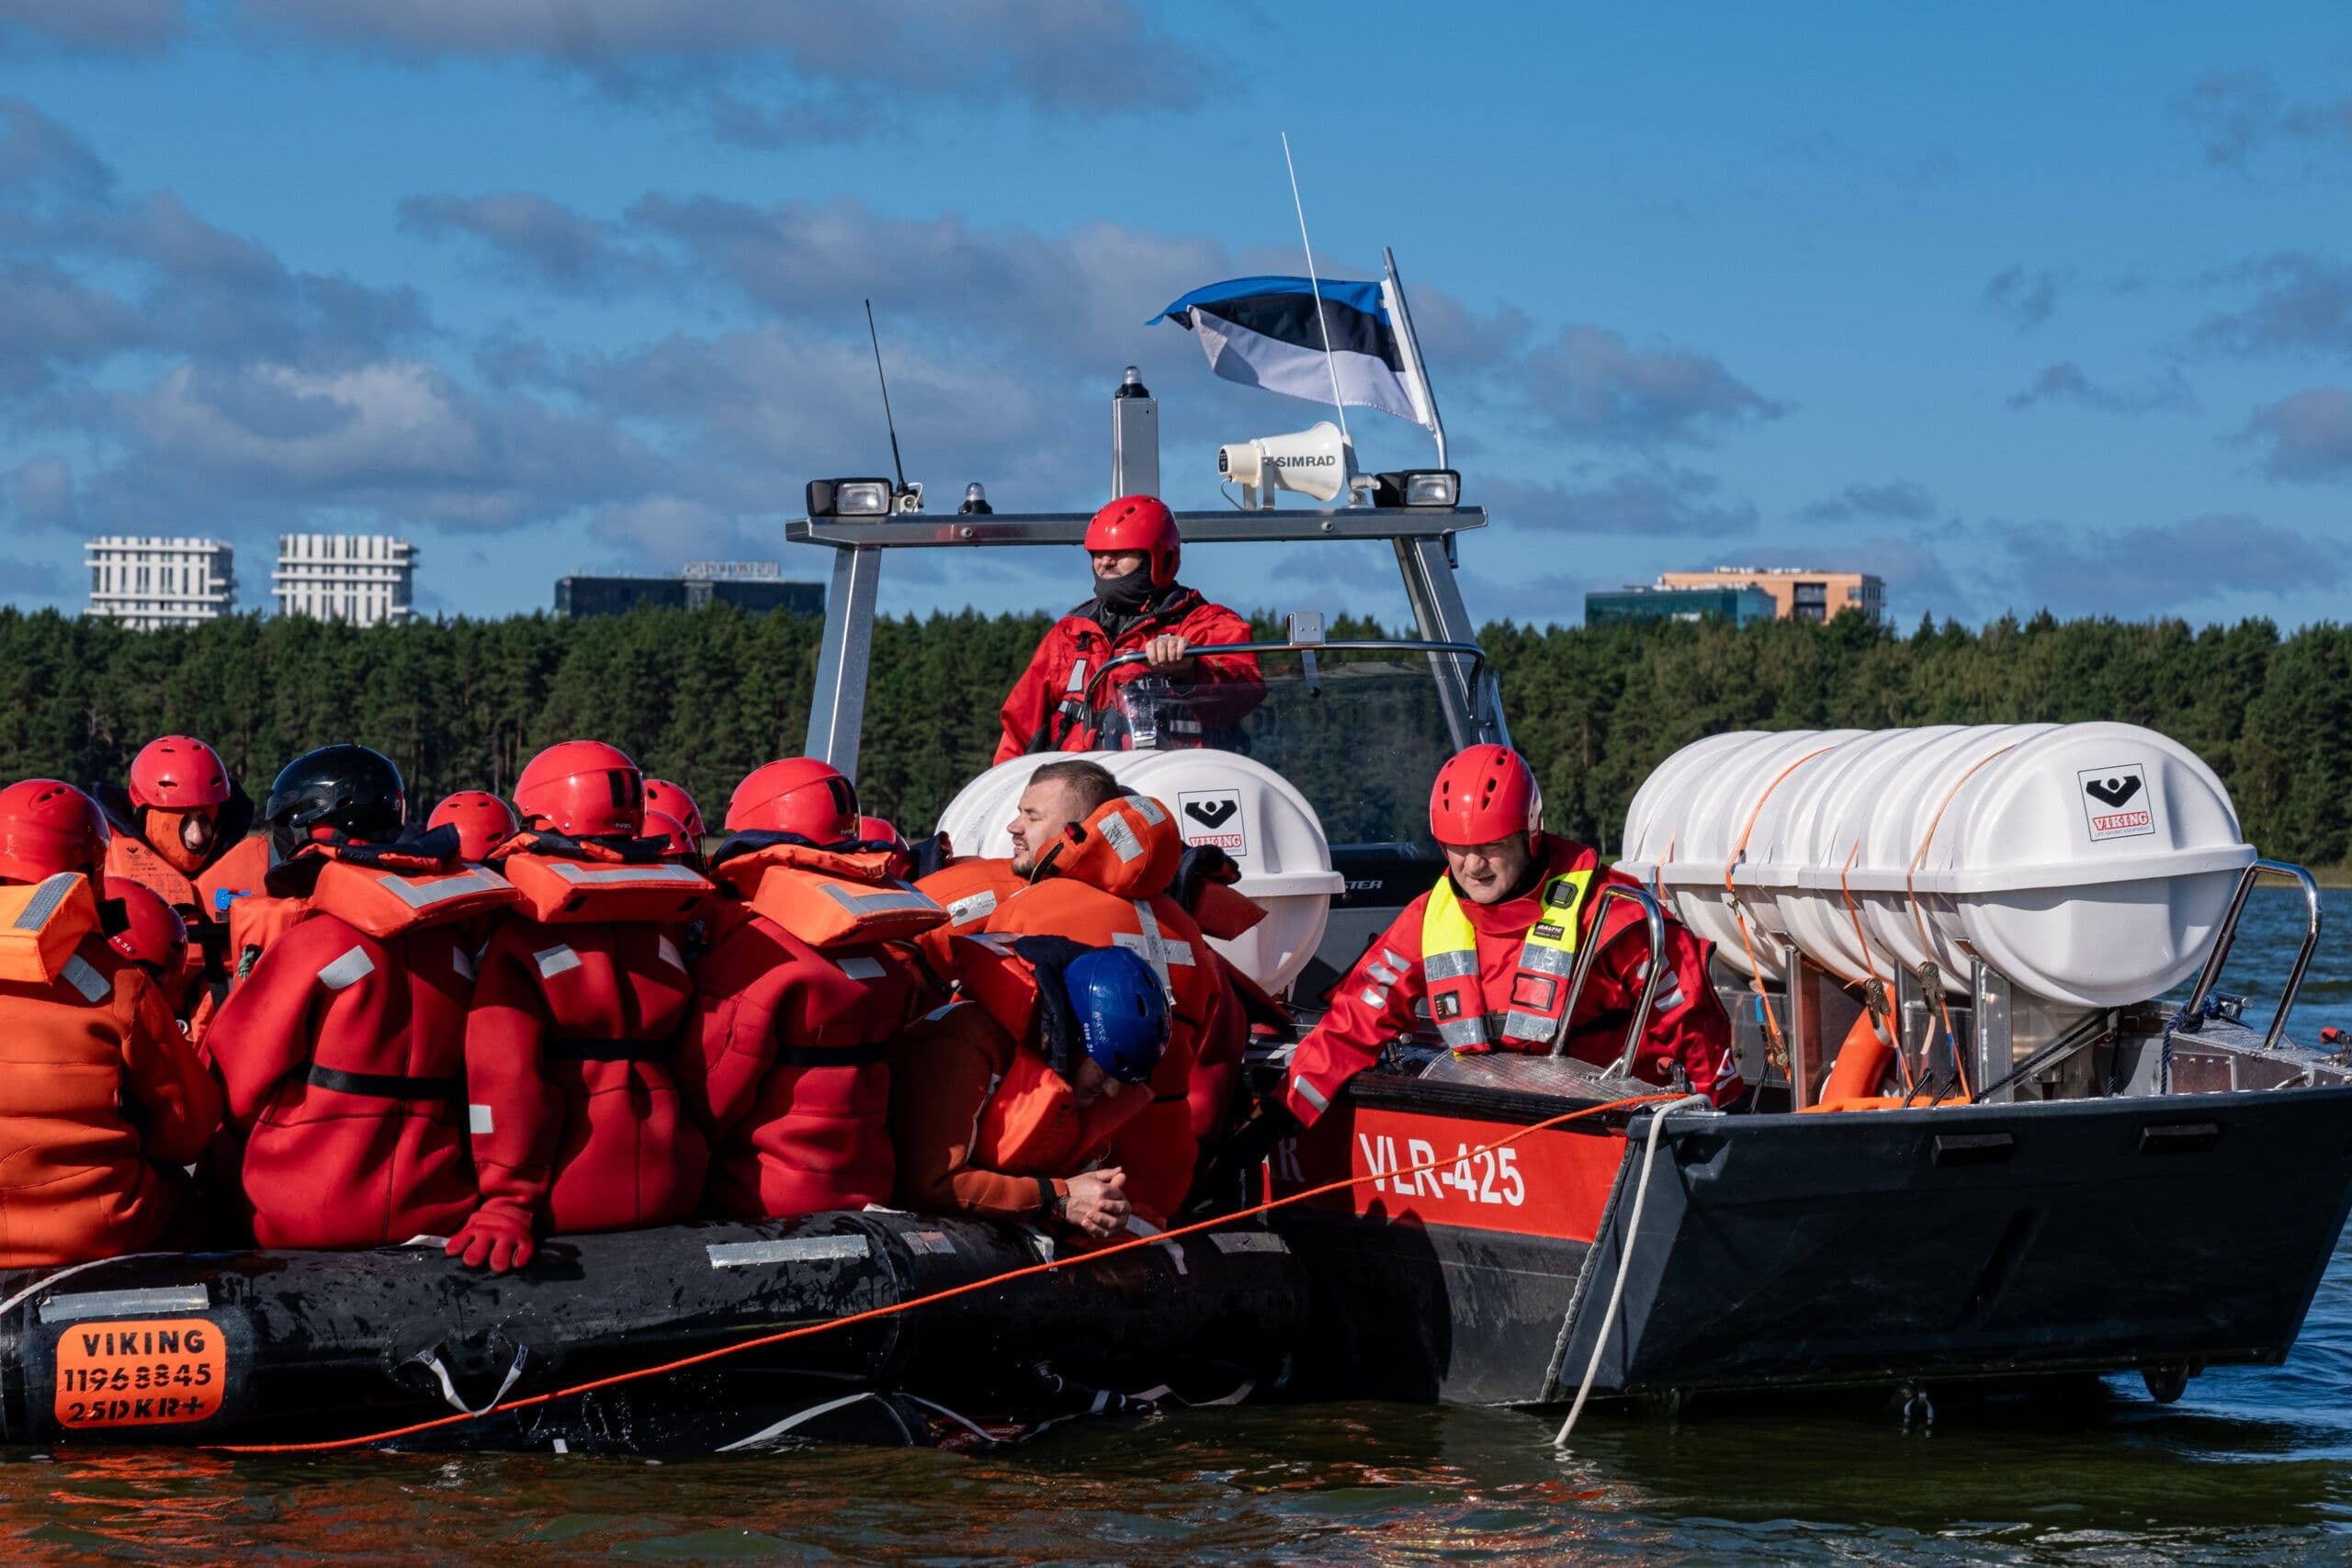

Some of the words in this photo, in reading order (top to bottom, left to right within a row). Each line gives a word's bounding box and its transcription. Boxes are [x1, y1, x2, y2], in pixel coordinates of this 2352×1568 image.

[1275, 456, 1336, 468] SIMRAD
[2093, 811, 2149, 831] VIKING
[1189, 834, 1242, 848] VIKING
[1359, 1134, 1525, 1207] VLR-425
[83, 1329, 205, 1357] VIKING
[64, 1363, 211, 1392] 11968845
